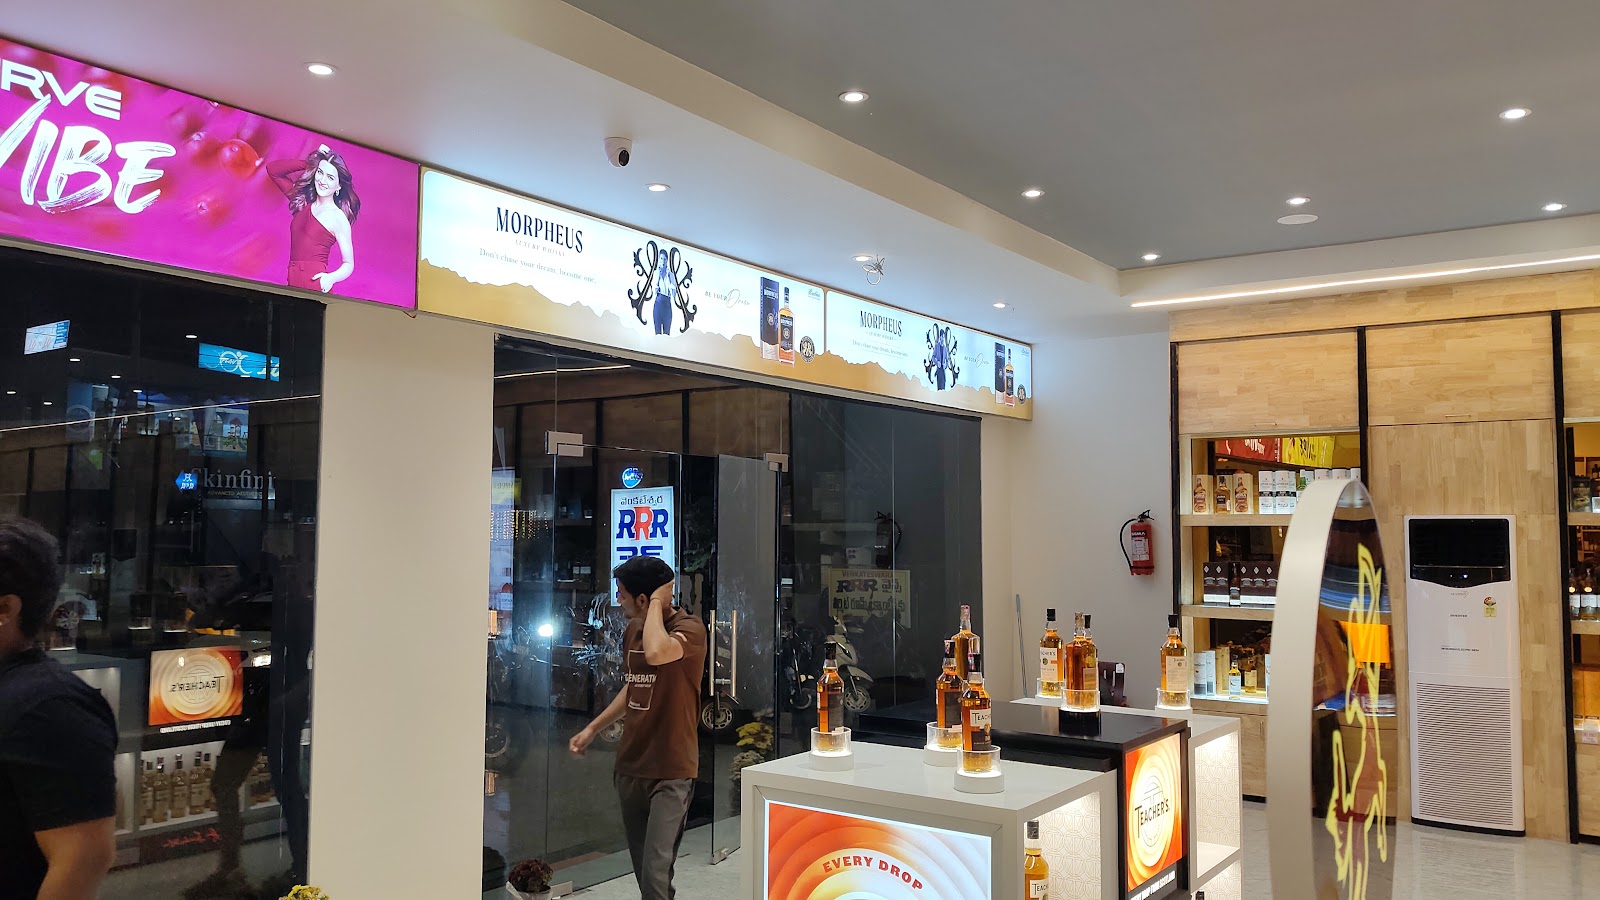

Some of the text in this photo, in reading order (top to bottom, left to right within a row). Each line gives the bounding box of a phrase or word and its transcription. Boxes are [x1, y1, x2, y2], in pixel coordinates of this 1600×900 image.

[496, 207, 584, 254] MORPHEUS
[479, 248, 500, 259] Don't
[500, 253, 519, 265] chase
[520, 259, 536, 270] your
[559, 268, 582, 280] become
[859, 310, 902, 337] MORPHEUS
[191, 467, 276, 490] kinfini
[616, 506, 669, 540] RRR
[836, 578, 878, 593] RRR
[1134, 798, 1171, 838] TEACHER'S
[822, 855, 924, 891] EVERY DROP
